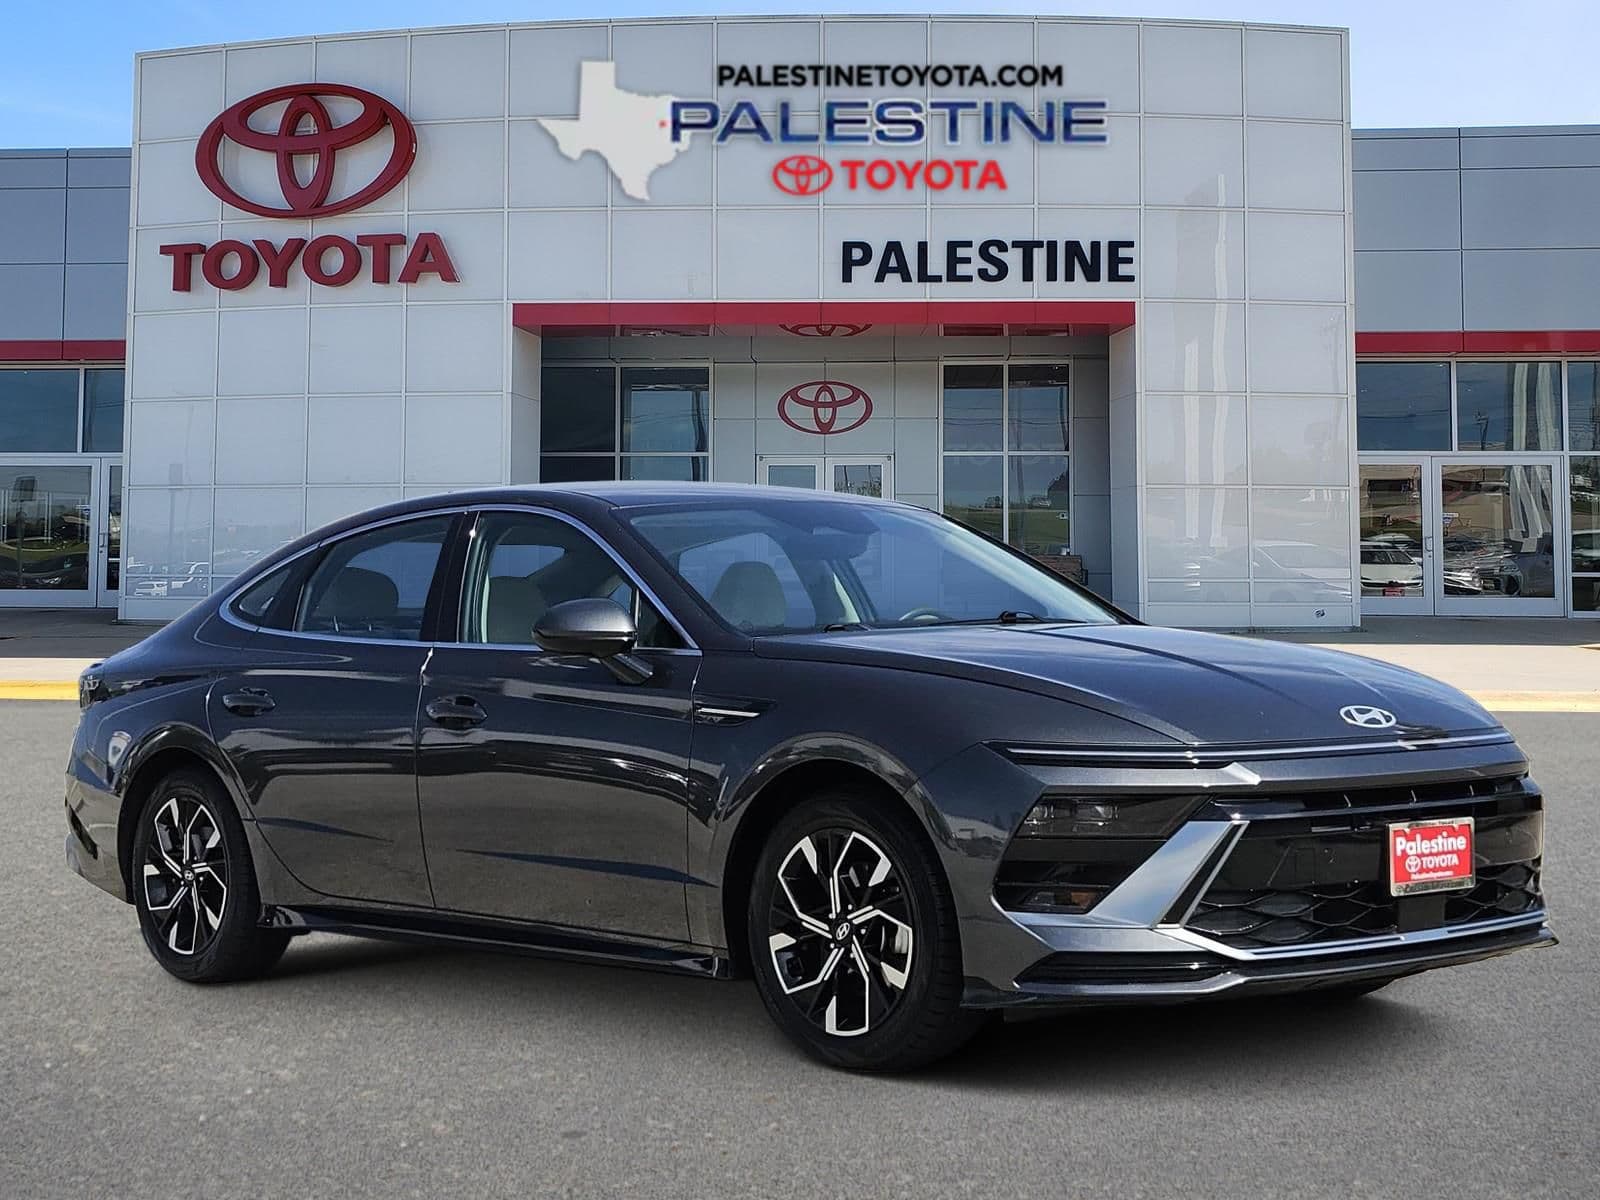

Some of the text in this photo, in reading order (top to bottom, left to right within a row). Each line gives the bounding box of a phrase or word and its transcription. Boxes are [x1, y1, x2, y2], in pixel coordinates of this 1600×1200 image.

[160, 232, 461, 292] TOYOTA
[842, 239, 1135, 284] PALESTINE
[1395, 831, 1466, 857] Palestine
[1421, 853, 1459, 869] TOYOTA
